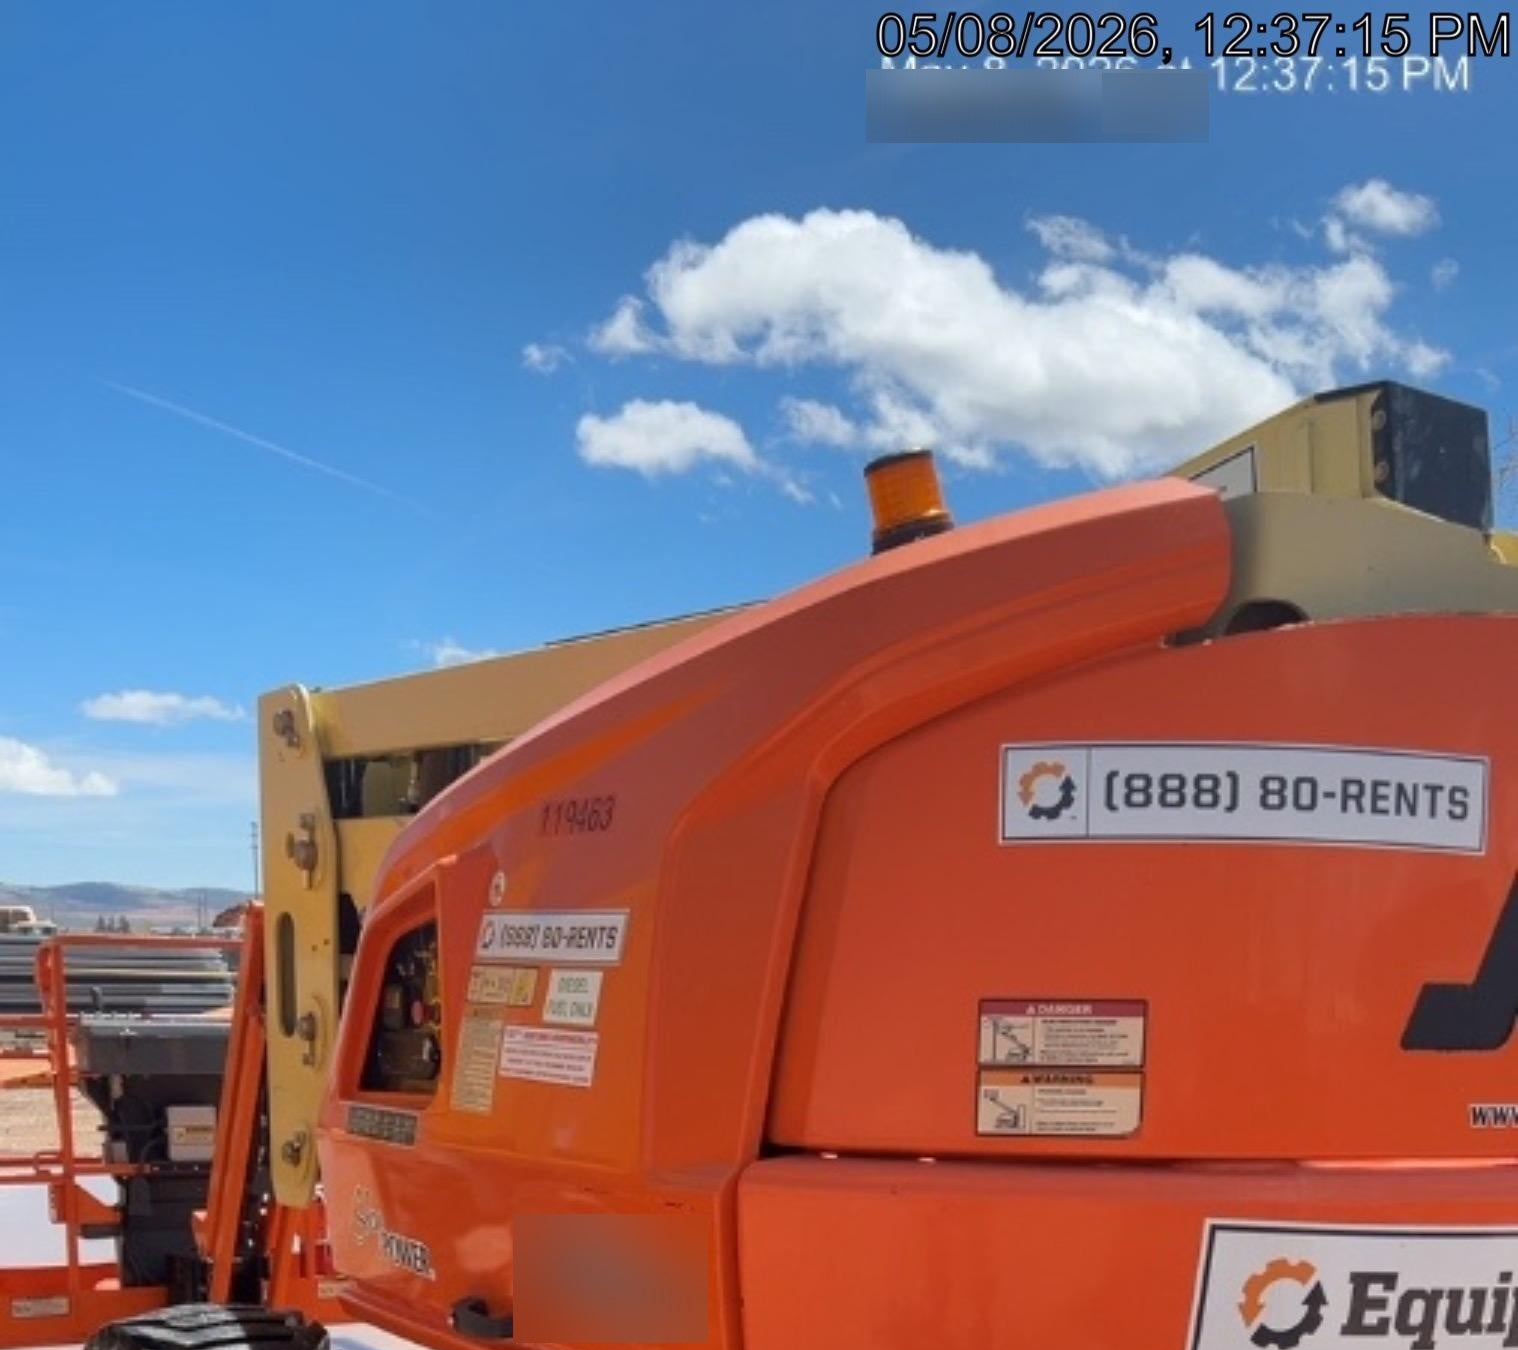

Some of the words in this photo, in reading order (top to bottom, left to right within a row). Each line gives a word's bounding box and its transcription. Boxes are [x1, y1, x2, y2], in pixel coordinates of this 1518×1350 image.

[541, 795, 616, 835] 119463
[1105, 770, 1240, 813] (888)
[1259, 776, 1471, 821] 80-RENTS
